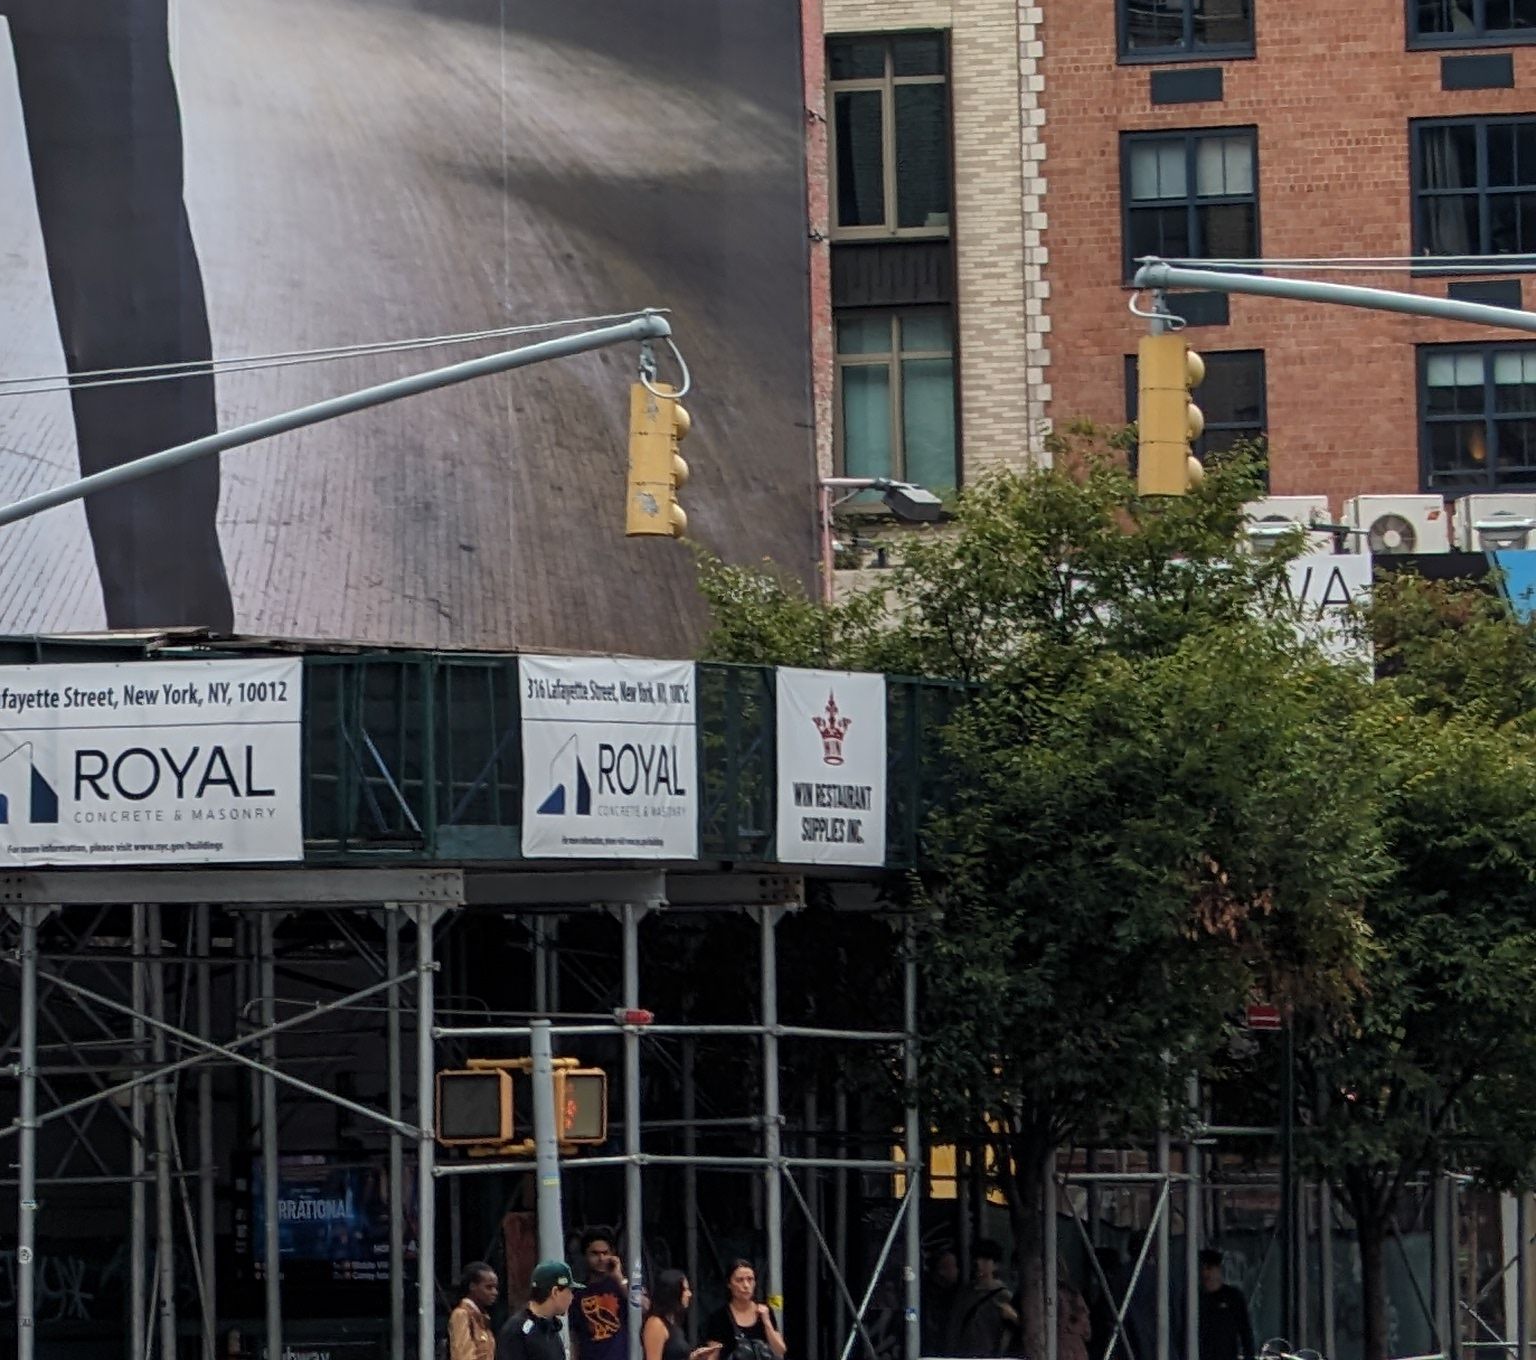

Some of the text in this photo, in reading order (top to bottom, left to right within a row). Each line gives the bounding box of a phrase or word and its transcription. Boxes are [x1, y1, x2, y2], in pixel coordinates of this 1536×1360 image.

[63, 685, 119, 710] Street,
[123, 684, 159, 706] New
[162, 682, 203, 707] York,
[208, 681, 232, 707] NY,
[238, 681, 287, 702] 10012
[74, 745, 275, 801] ROYAL
[598, 743, 686, 796] ROYAL
[792, 781, 872, 811] WIN RESTAURANT
[74, 808, 277, 824] CONCRETE & MASONRY
[801, 816, 845, 843] SUPPLIES
[277, 1198, 354, 1220] RRATIONAL
